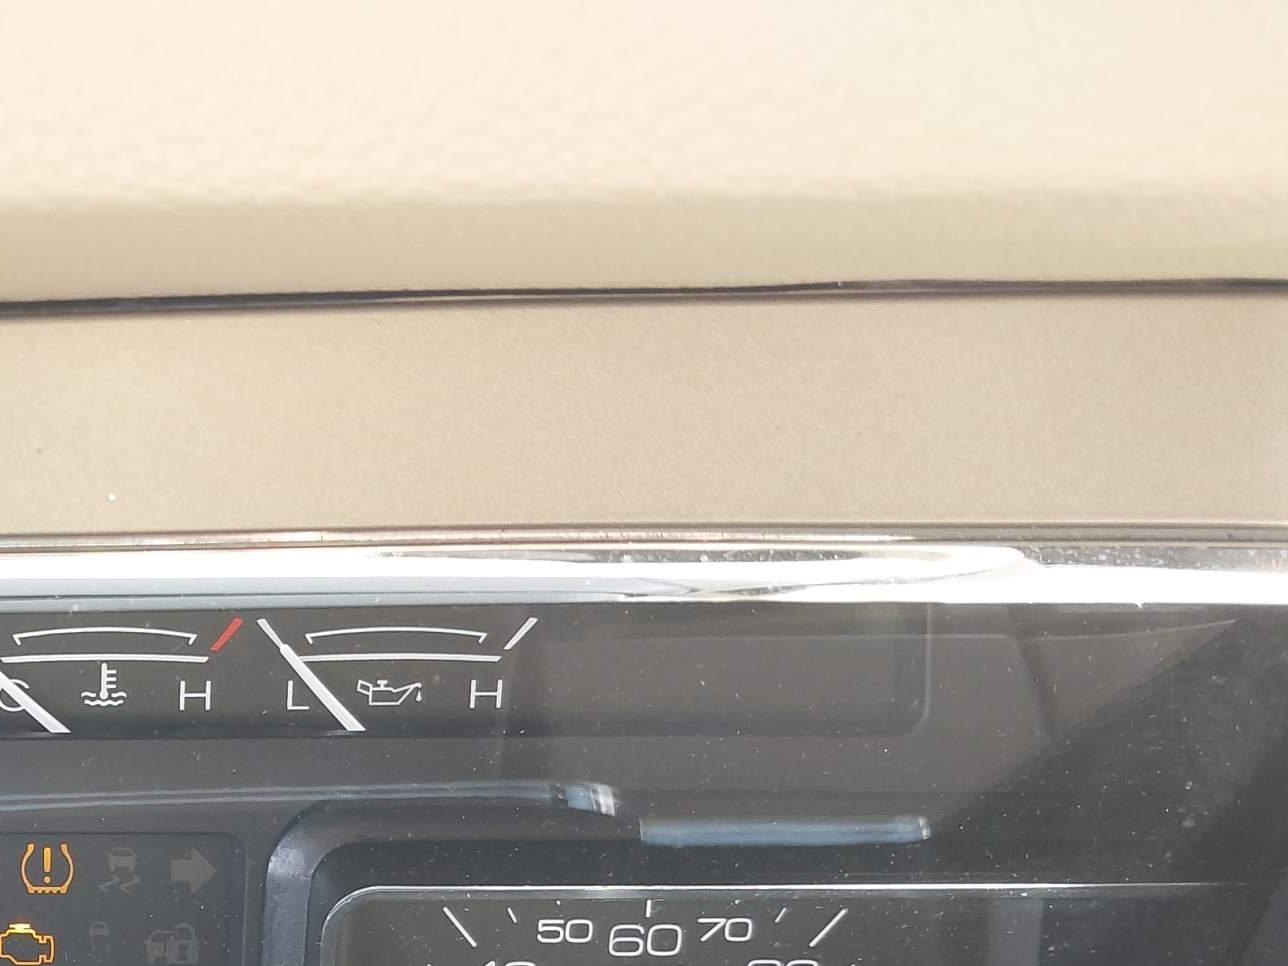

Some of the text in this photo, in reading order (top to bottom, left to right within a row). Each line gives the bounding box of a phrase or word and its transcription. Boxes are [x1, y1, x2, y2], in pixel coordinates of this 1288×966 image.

[179, 680, 211, 711] H
[287, 680, 309, 711] L
[469, 679, 502, 709] H
[537, 919, 594, 944] 50
[608, 924, 683, 957] 60
[697, 917, 753, 942] 70
